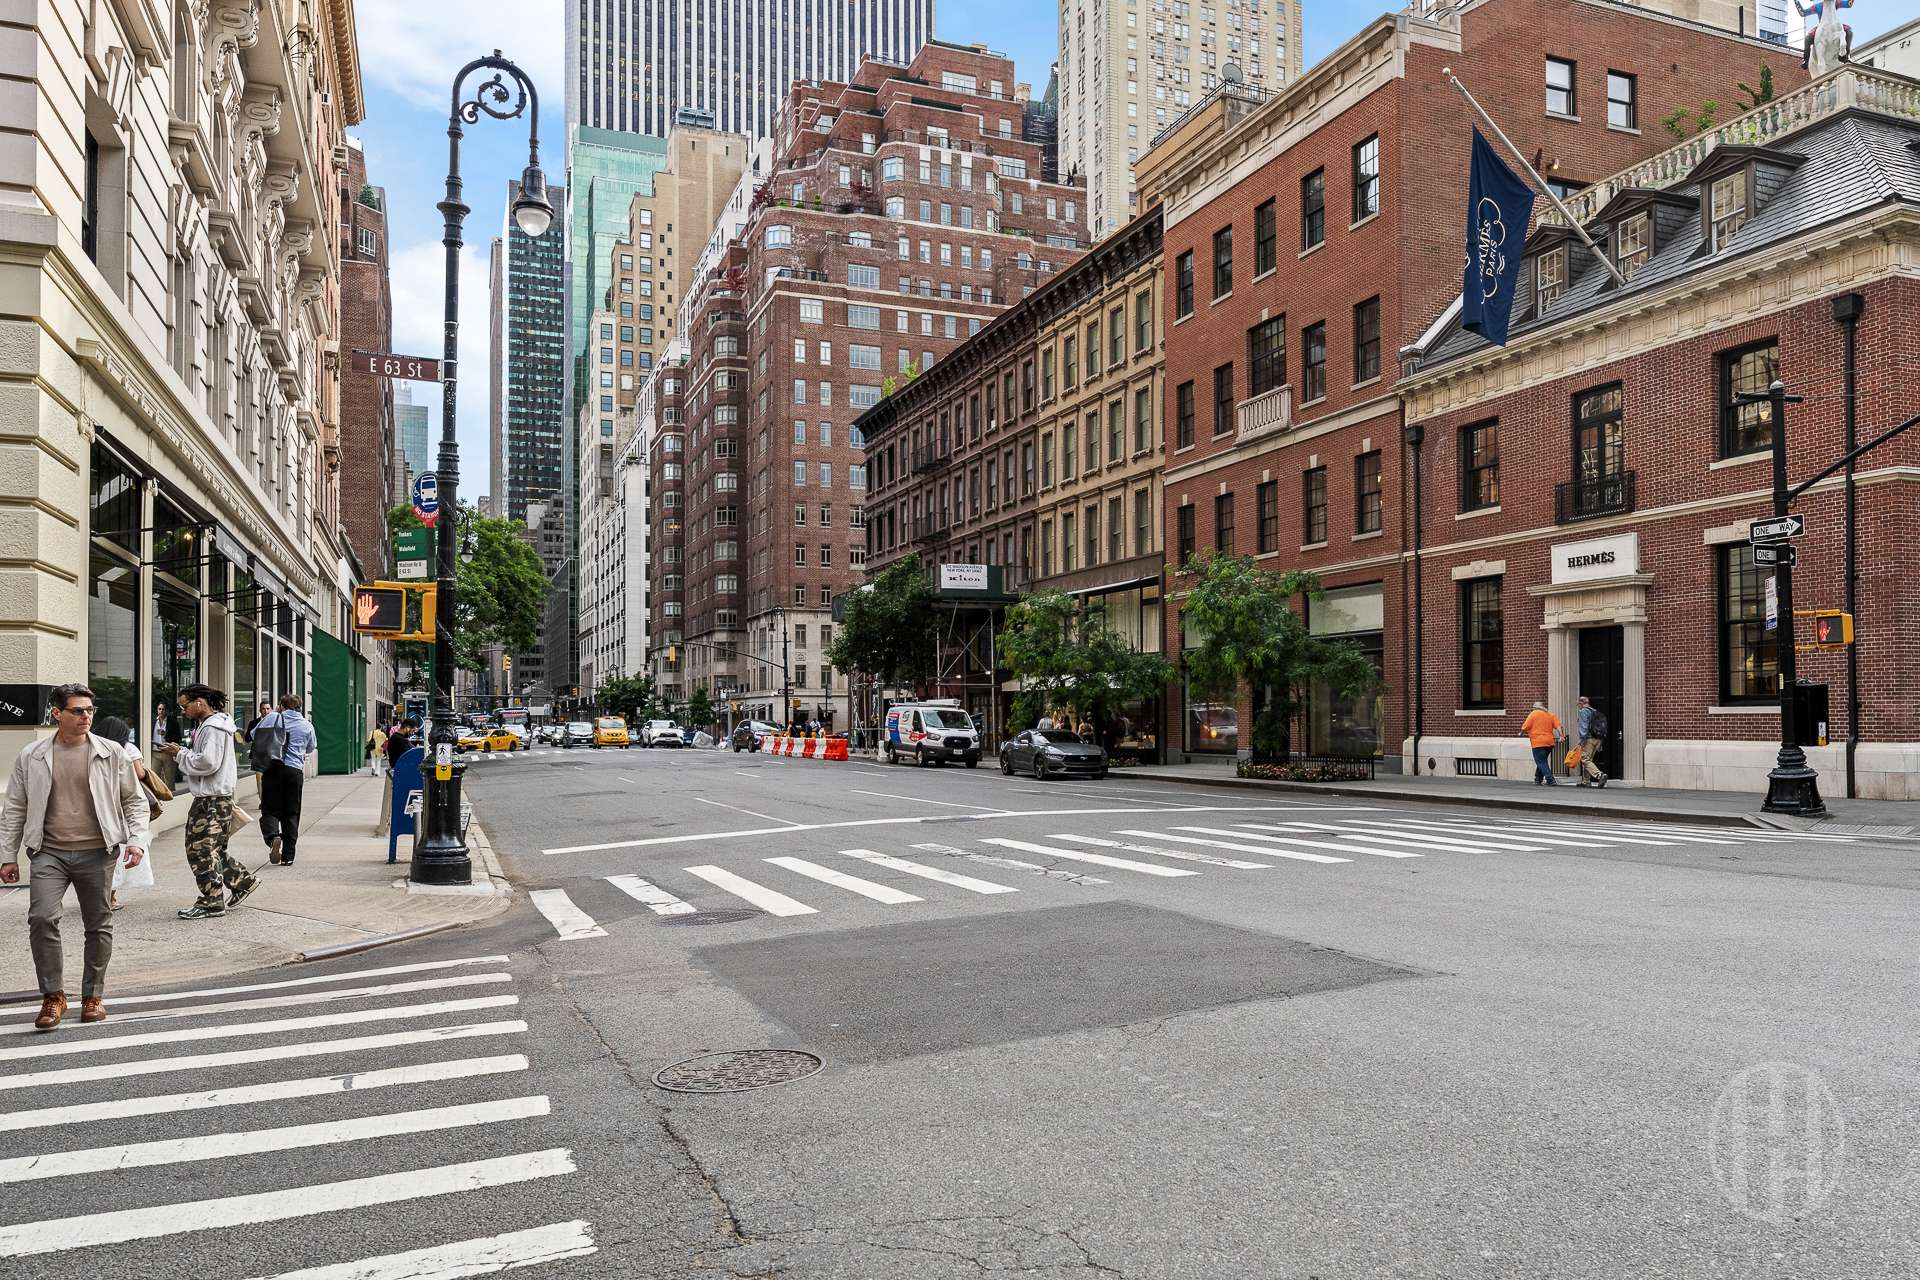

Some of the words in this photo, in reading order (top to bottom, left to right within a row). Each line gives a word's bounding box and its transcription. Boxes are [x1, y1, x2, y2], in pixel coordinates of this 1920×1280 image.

[1485, 239, 1498, 277] PARIS
[370, 357, 377, 373] E
[384, 359, 401, 376] 63
[407, 362, 423, 378] St
[1755, 526, 1770, 536] ONE
[1779, 522, 1795, 532] WAY
[1757, 550, 1770, 559] ONE
